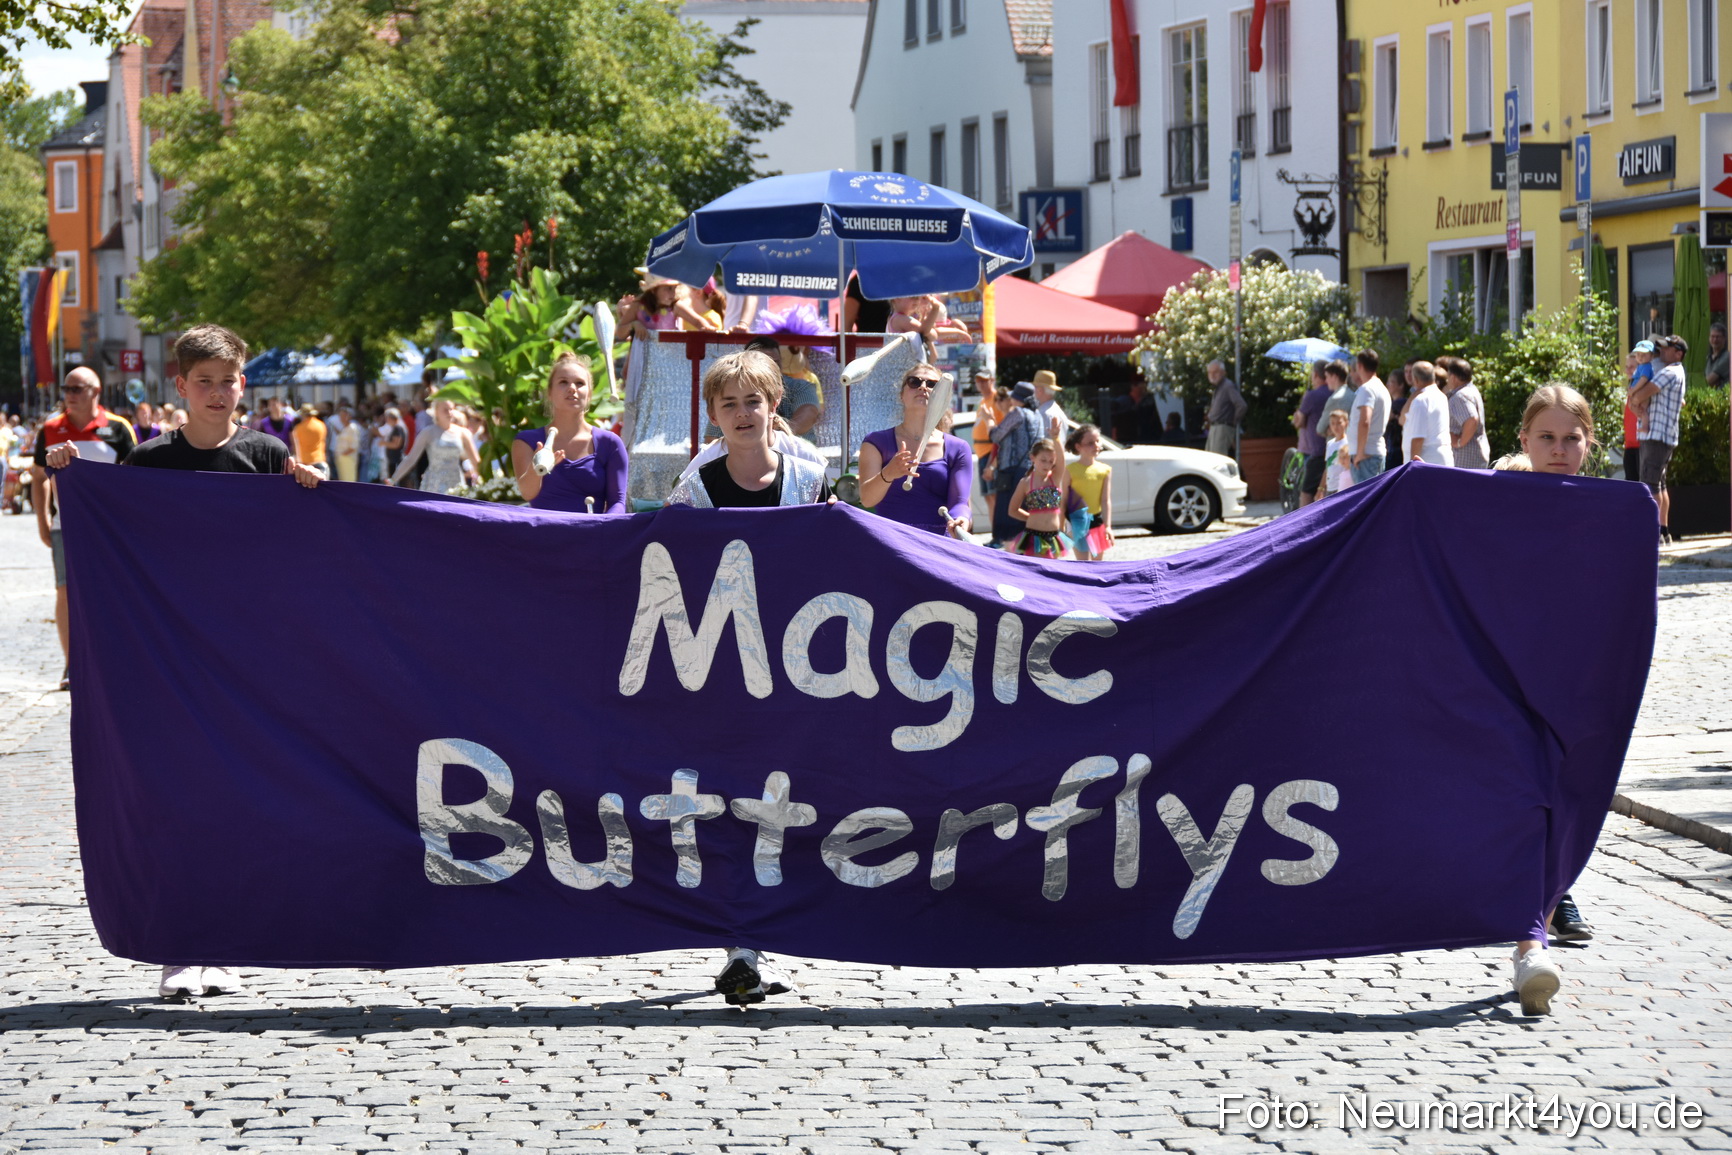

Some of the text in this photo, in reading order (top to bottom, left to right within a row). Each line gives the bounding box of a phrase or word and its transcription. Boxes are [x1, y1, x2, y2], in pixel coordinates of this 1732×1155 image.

[1507, 98, 1516, 146] P
[1496, 172, 1558, 184] TIFUN
[1578, 144, 1588, 193] P
[1615, 144, 1662, 178] TAIFUN
[842, 217, 903, 232] SCHNEIDER
[906, 219, 948, 234] WEISSE
[1436, 194, 1504, 230] Restaurant
[1019, 333, 1046, 344] Hotel
[1048, 333, 1102, 344] Restaurant
[618, 538, 1119, 753] Magic
[415, 737, 1341, 940] Butterflys
